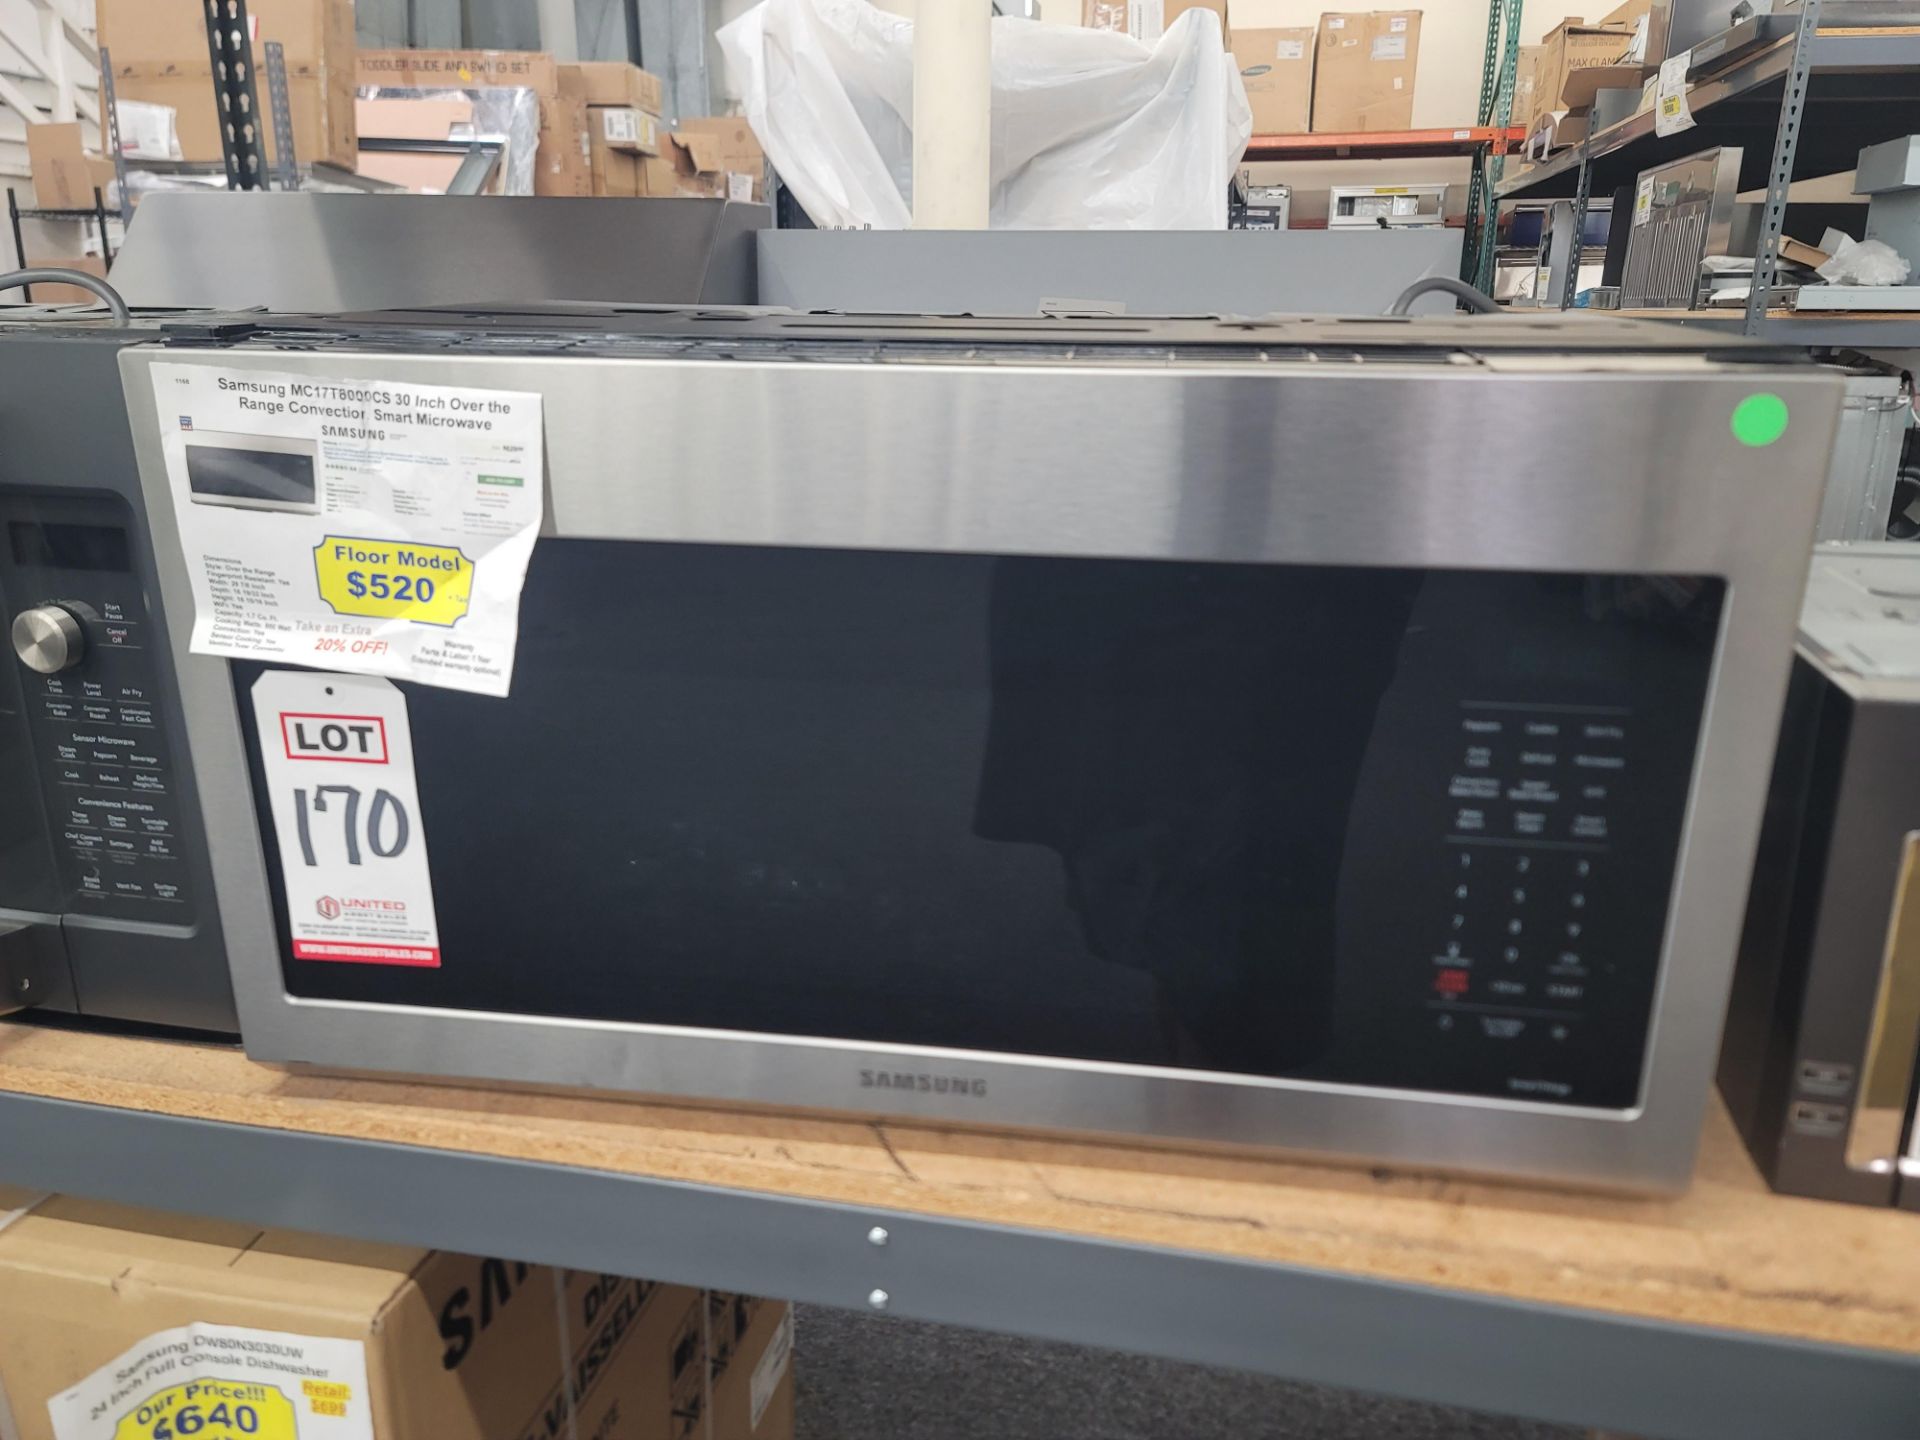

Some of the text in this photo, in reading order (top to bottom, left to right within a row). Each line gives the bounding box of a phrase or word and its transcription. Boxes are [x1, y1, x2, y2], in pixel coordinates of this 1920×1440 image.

[360, 59, 409, 72] TODDLER
[511, 62, 531, 74] SET
[217, 377, 286, 398] Samsung
[395, 393, 411, 406] 30
[415, 395, 445, 409] Inch
[450, 397, 484, 412] Over
[488, 400, 511, 414] the
[239, 396, 285, 414] Range
[374, 409, 413, 425] Smart
[416, 413, 493, 430] Microwave
[321, 424, 386, 441] SAMSUNG
[335, 545, 461, 572] Floor Model
[346, 570, 435, 603] $520
[104, 602, 121, 612] Start
[105, 611, 124, 621] Pause
[106, 627, 128, 637] Cancel
[295, 620, 322, 633] Take
[324, 624, 338, 634] an
[341, 623, 372, 636] Extra
[112, 636, 123, 645] Off
[314, 637, 389, 655] 20% OFF!
[122, 687, 143, 698] Air Fry
[72, 732, 136, 747] Sensor Microwave
[294, 722, 374, 753] LOT
[64, 771, 80, 779] Cook
[78, 797, 154, 812] Convenience Features
[293, 784, 409, 867] 170
[115, 882, 129, 890] Vent
[341, 898, 406, 911] UNITED
[860, 1069, 988, 1098] SAMSUNG
[115, 1342, 189, 1384] Samsung
[90, 1353, 329, 1421] 24 Inch Full Console Dishwasher
[136, 1380, 267, 1426] Our Price!!!
